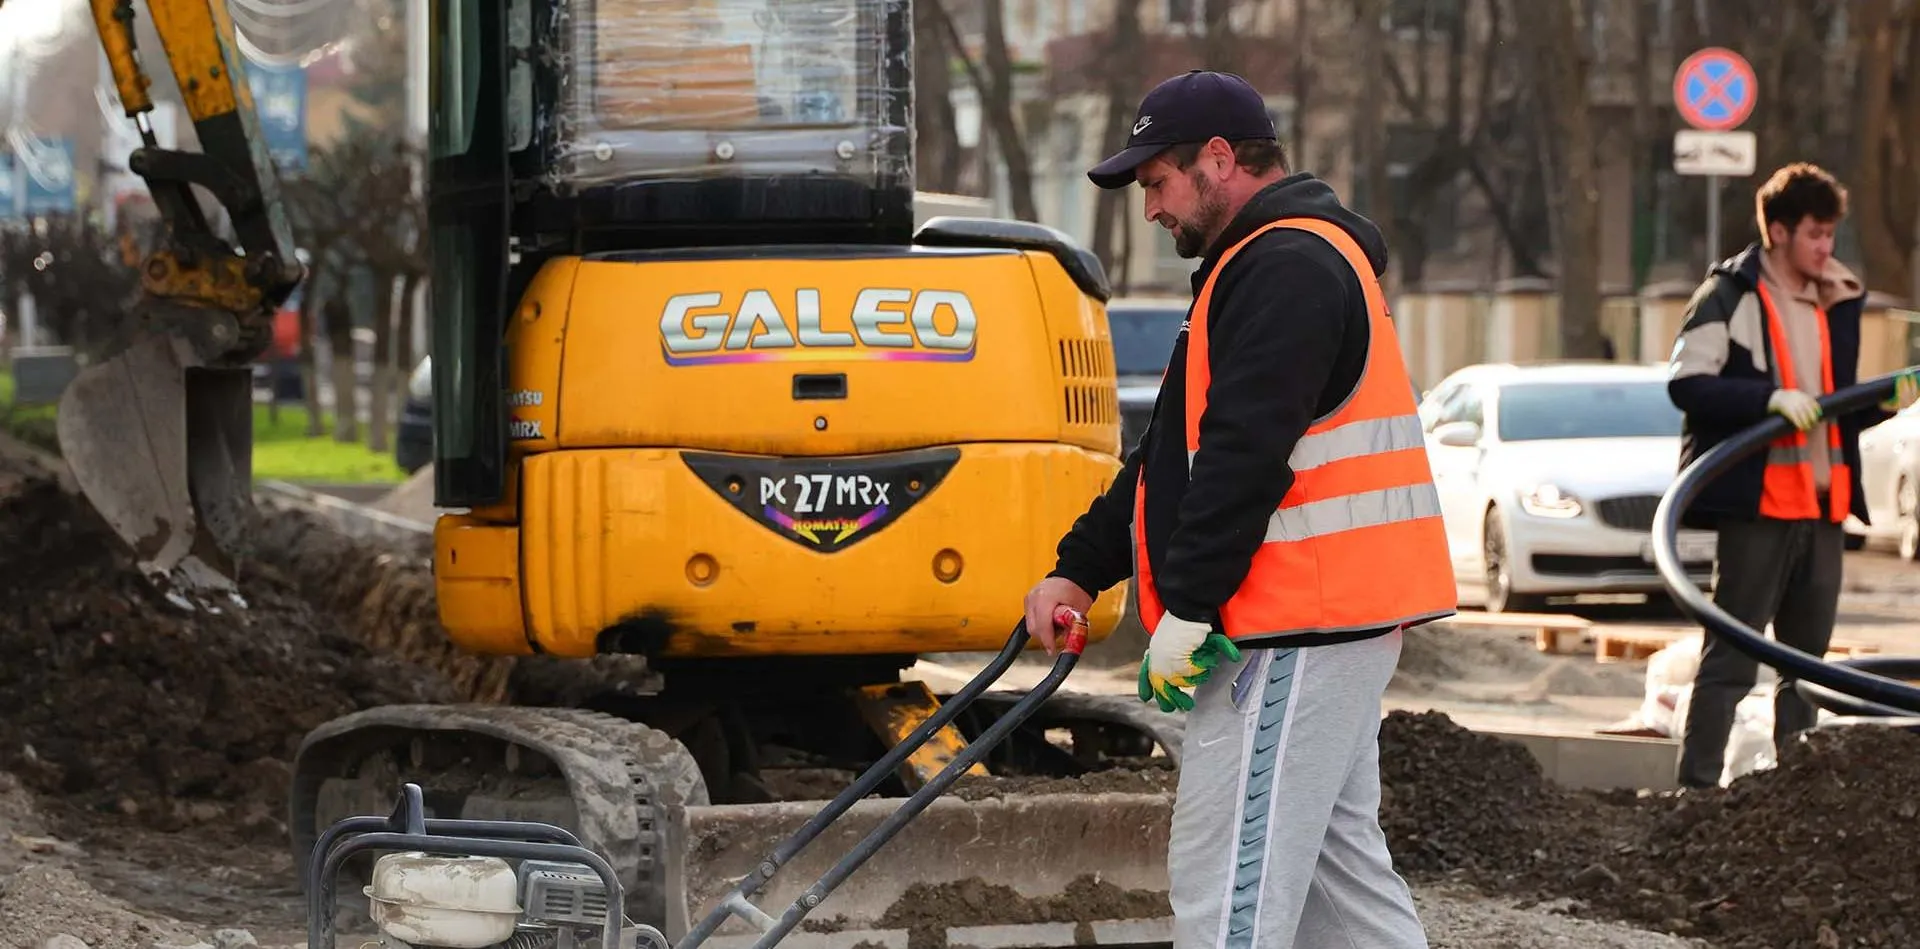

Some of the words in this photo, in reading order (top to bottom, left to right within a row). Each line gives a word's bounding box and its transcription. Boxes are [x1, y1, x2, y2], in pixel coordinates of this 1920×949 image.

[659, 288, 977, 353] GALEO
[760, 476, 786, 505] PC
[794, 474, 832, 512] 27
[792, 518, 859, 531] KOMATSU
